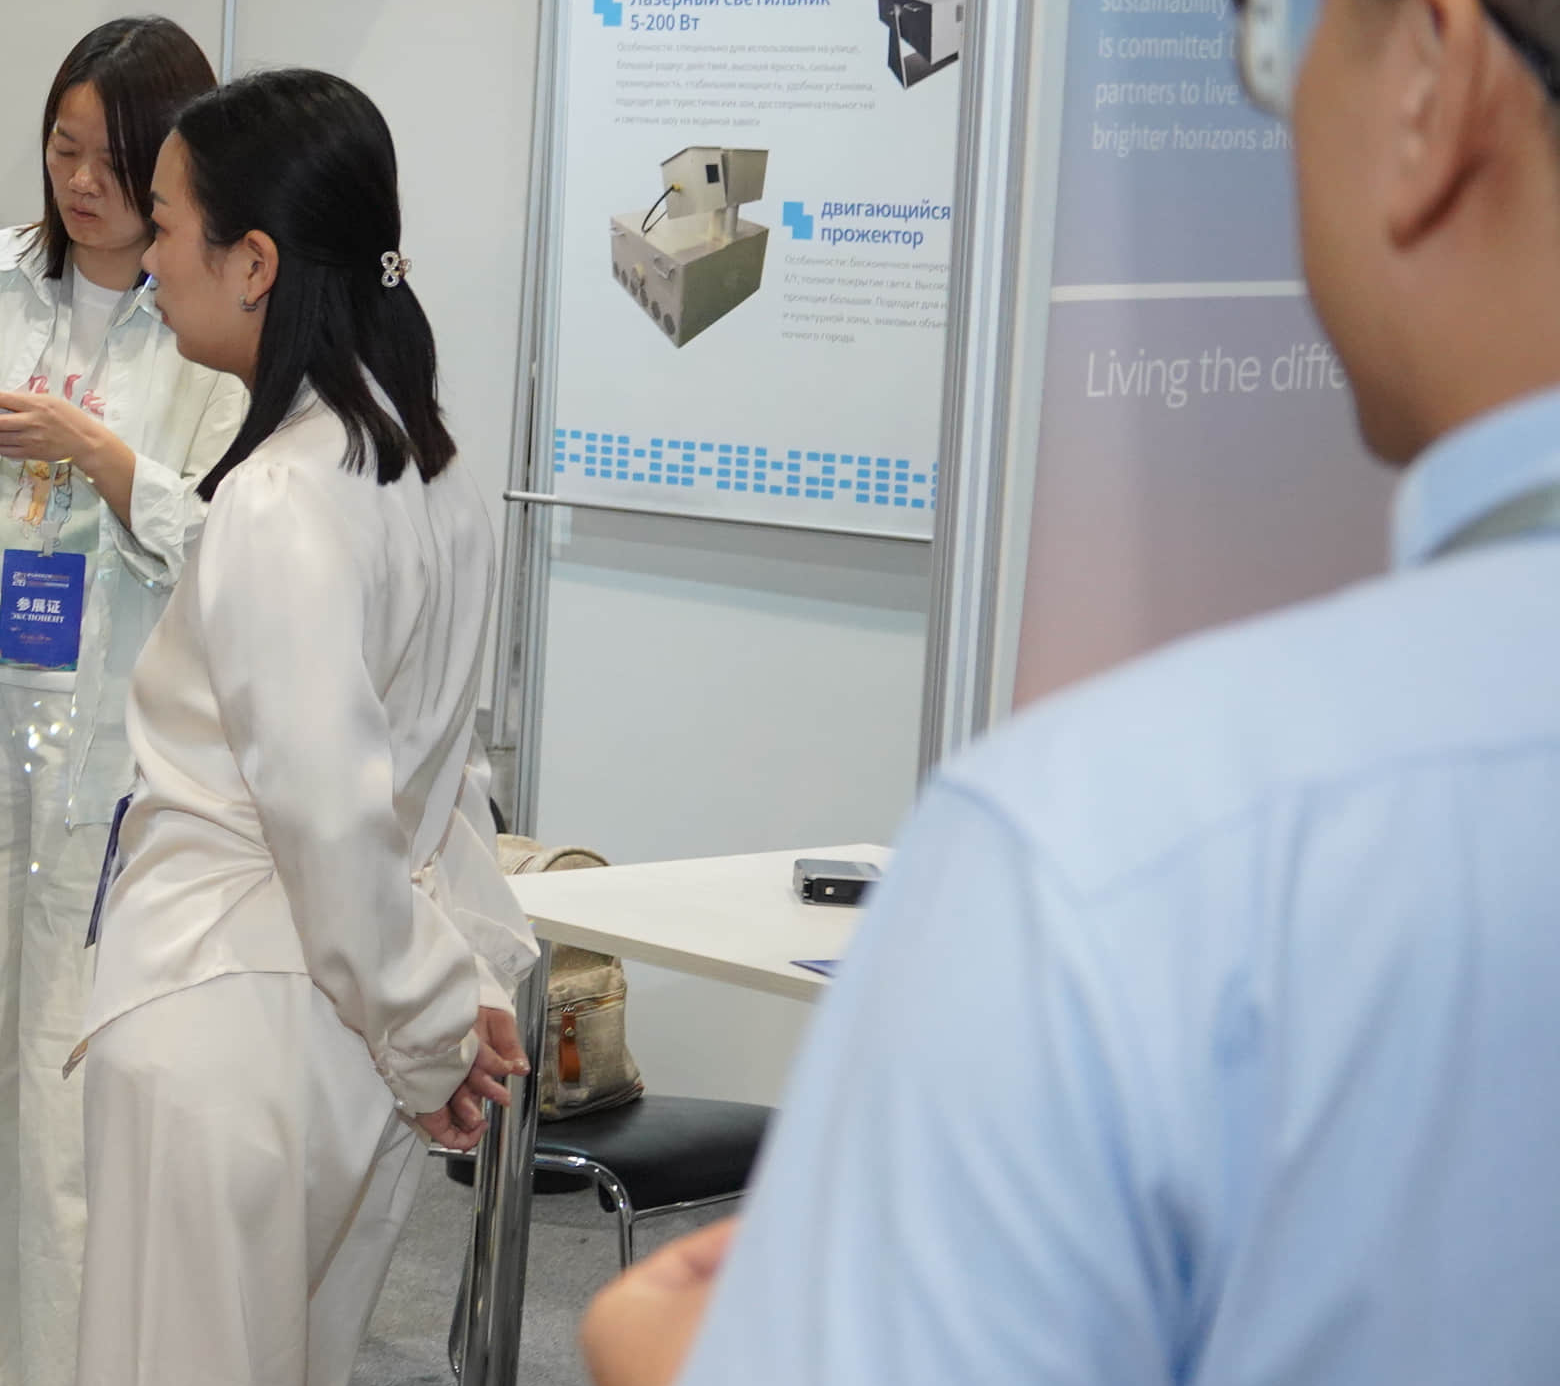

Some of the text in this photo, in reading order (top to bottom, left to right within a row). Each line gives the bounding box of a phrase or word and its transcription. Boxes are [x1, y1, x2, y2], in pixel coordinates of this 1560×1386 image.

[630, 13, 700, 31] 5-200 Вт
[820, 199, 952, 224] двигающийся
[820, 227, 924, 250] прожектор
[1086, 349, 1190, 410] Living
[1198, 345, 1261, 394] the
[16, 597, 61, 614] 参展证
